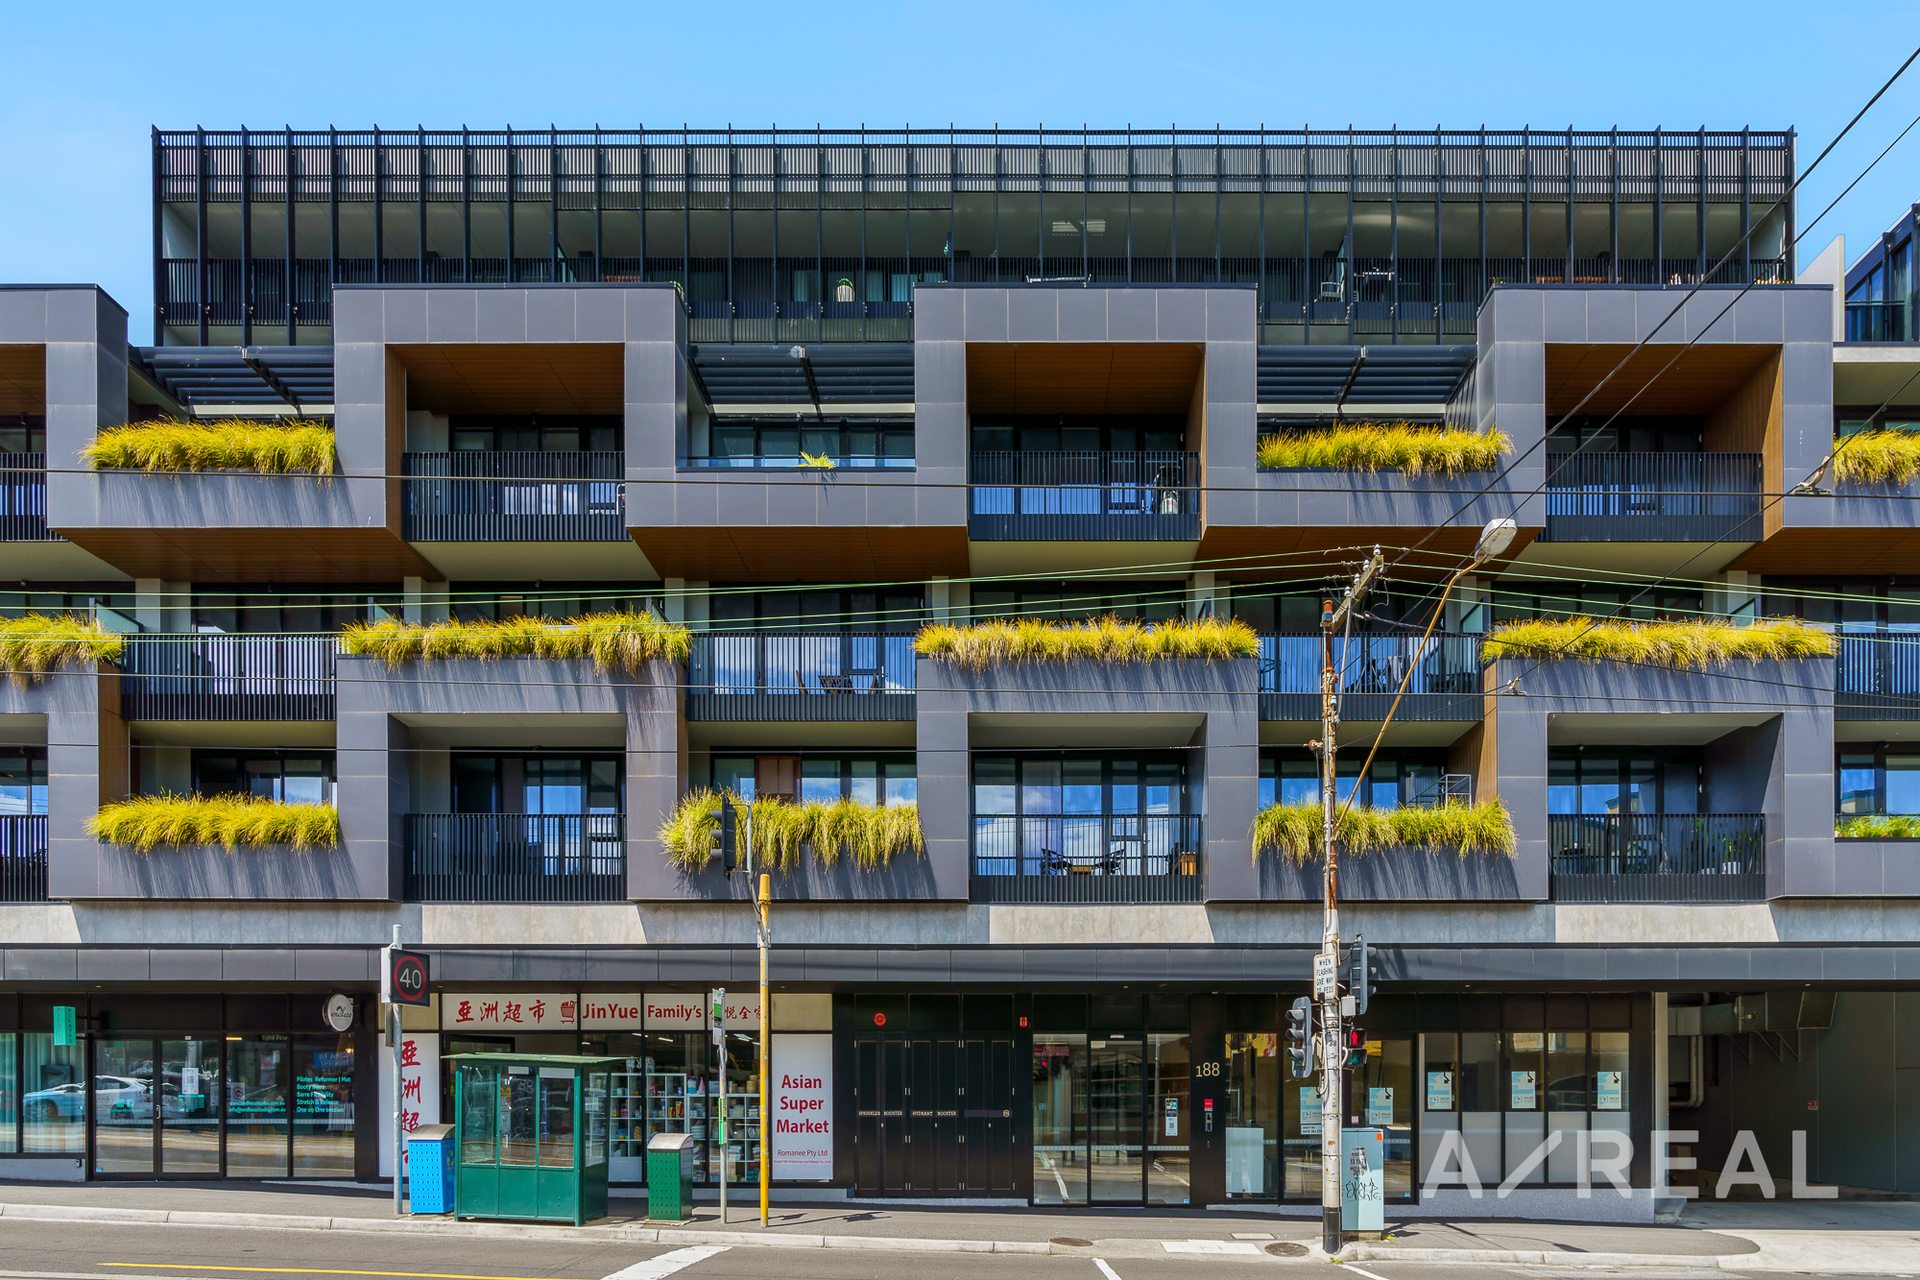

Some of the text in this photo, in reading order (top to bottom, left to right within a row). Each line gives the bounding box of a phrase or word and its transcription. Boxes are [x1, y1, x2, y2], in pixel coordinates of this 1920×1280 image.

[400, 968, 421, 989] 40
[1316, 967, 1333, 977] FLASHING
[582, 1003, 638, 1019] JinYue
[1196, 1062, 1220, 1078] 188
[781, 1074, 822, 1089] Asian
[780, 1096, 824, 1114] Super
[776, 1118, 829, 1133] Market
[806, 1149, 817, 1157] Pty
